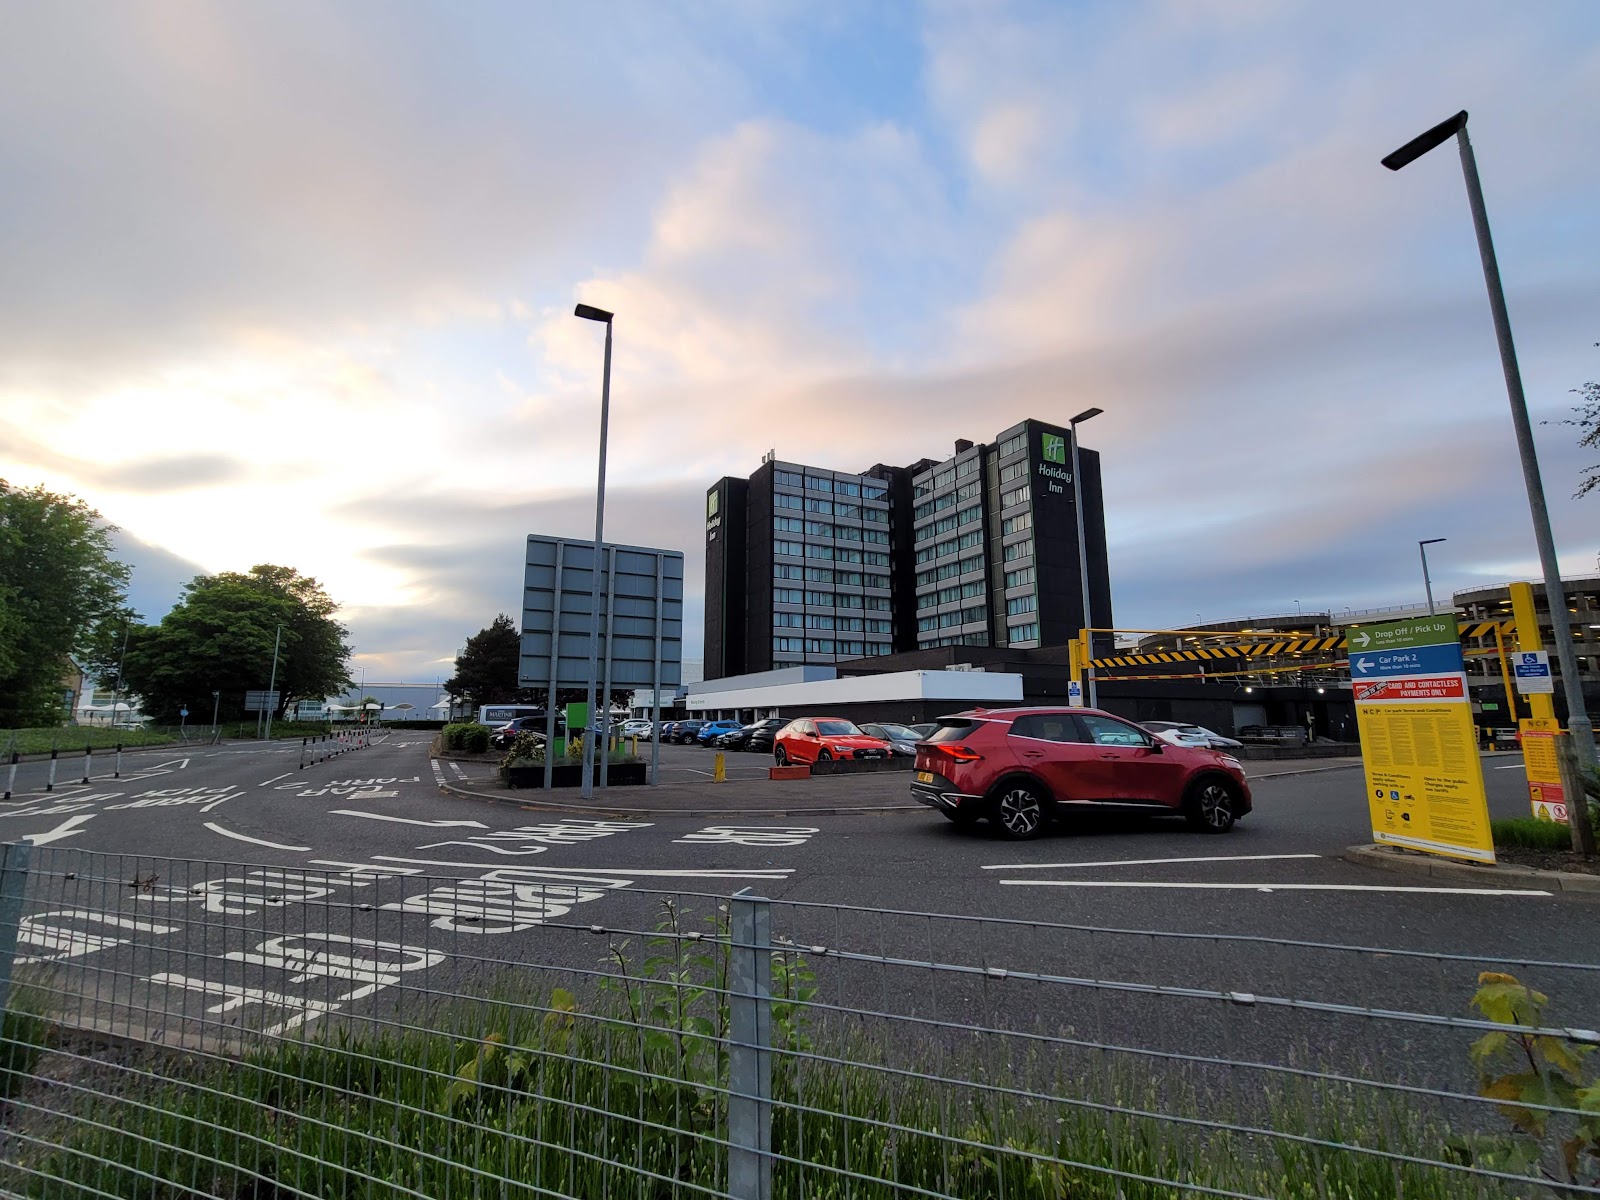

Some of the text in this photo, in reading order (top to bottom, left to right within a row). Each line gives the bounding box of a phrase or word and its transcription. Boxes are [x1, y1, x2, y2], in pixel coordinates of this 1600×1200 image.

[1038, 463, 1072, 484] Holiday
[1049, 480, 1063, 494] Inn
[1375, 629, 1393, 638] Drop
[1394, 626, 1407, 636] Off
[1415, 624, 1431, 634] Pick
[1433, 623, 1446, 632] Up
[1379, 656, 1392, 664] Car
[1387, 680, 1458, 690] CARD AND CONTACTLESS
[325, 777, 420, 787] PARK
[130, 785, 237, 798] PICK
[295, 785, 382, 797] CAR
[103, 794, 226, 810] DROP
[416, 818, 656, 856] PARK 2
[671, 825, 820, 848] CAR
[130, 859, 425, 915] PICK
[139, 869, 635, 1036] DROP OFF
